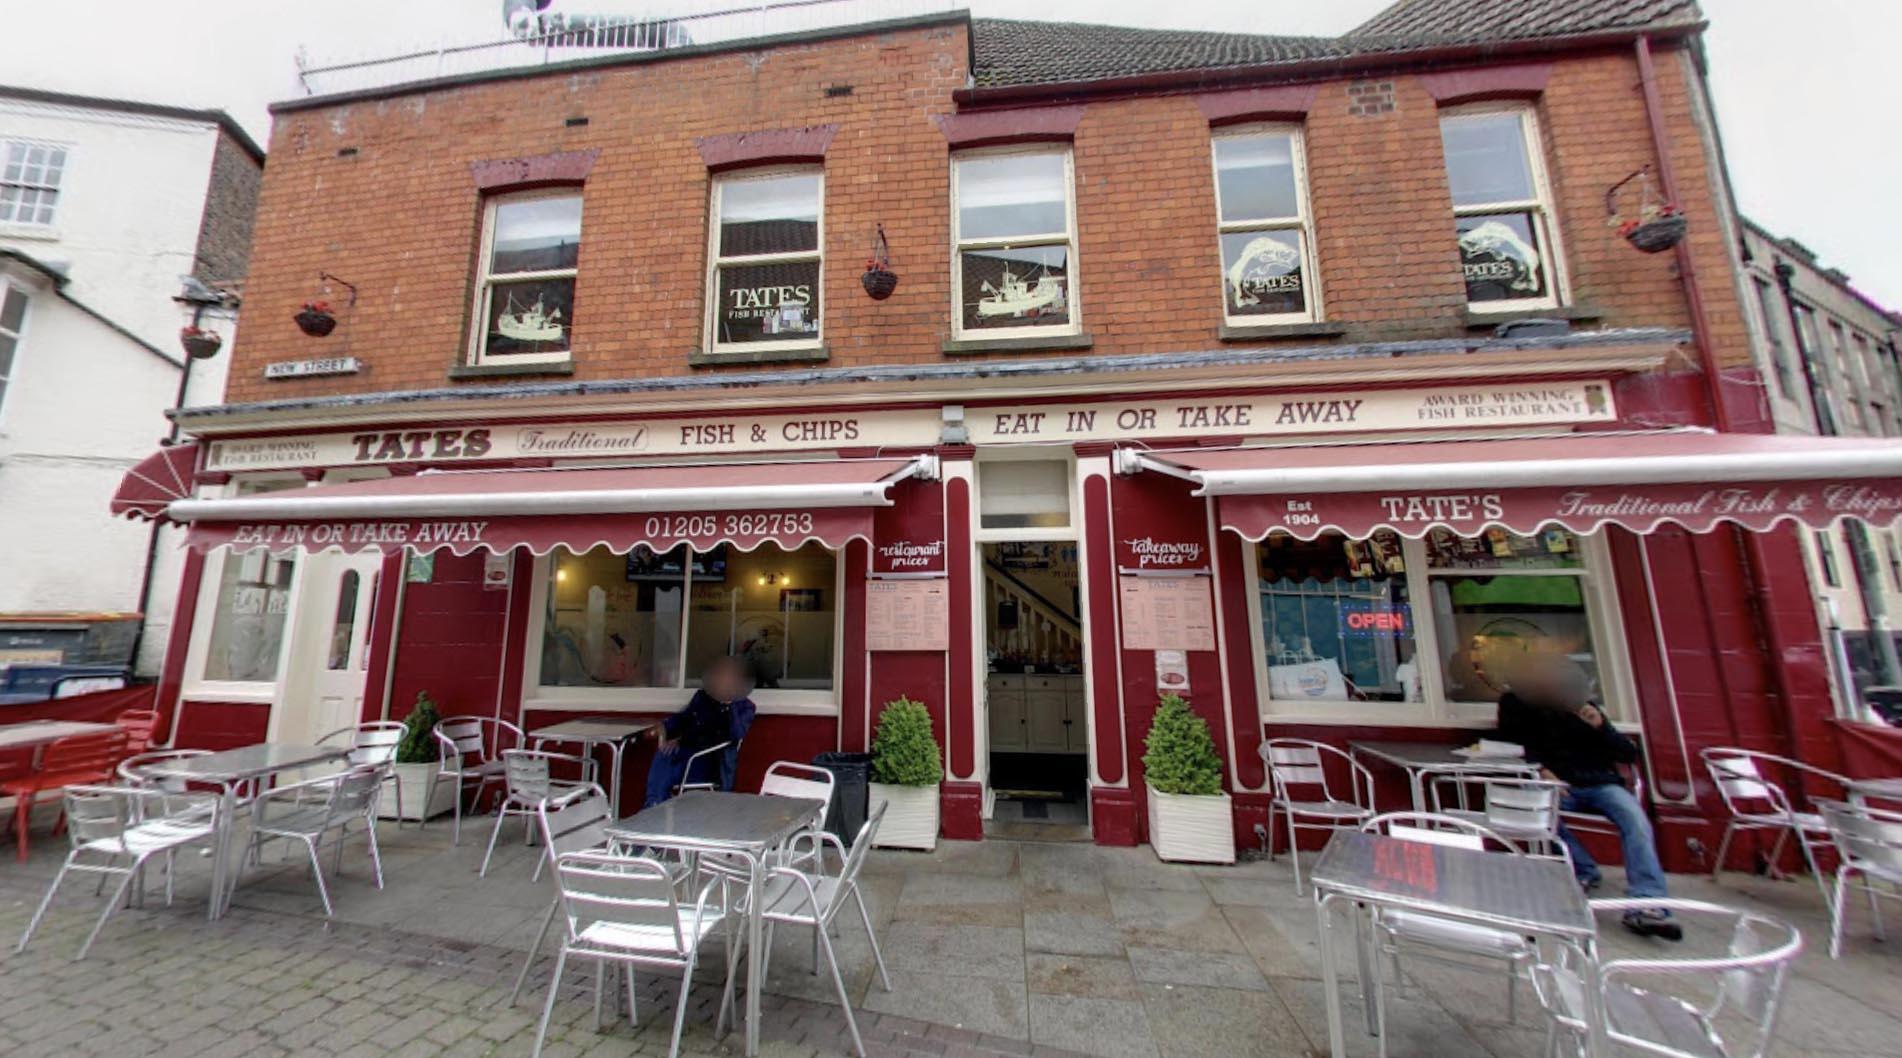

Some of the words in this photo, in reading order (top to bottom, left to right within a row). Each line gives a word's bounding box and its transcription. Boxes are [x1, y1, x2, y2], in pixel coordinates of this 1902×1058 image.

[730, 284, 811, 309] TATES
[728, 310, 750, 319] FISH
[271, 364, 296, 374] NEW
[304, 359, 346, 372] STREET
[1423, 393, 1483, 406] AWARD
[1492, 388, 1575, 403] WINNING
[993, 413, 1045, 435] EAT
[1065, 410, 1097, 432] IN
[1117, 408, 1157, 430] OR
[1178, 405, 1252, 428] TAKE
[1275, 400, 1363, 424] AWAY
[1418, 407, 1455, 419] FISH
[1465, 402, 1581, 417] RESTAURANT
[521, 425, 643, 450] Traditional
[680, 424, 735, 445] FISH
[750, 423, 767, 443] &
[782, 419, 859, 442] CHIPS
[352, 429, 492, 461] TATES
[1287, 500, 1312, 511] Est
[1381, 495, 1504, 522] TATE'S
[1557, 490, 1713, 516] Traditional
[1714, 487, 1780, 514] Fish
[1786, 495, 1811, 512] &
[645, 516, 717, 538] 01205
[724, 513, 813, 536] 362753
[1283, 514, 1320, 525] 1904
[233, 525, 280, 543] EAT
[281, 524, 309, 543] IN
[312, 523, 344, 543] OR
[349, 522, 409, 543] TAKE
[414, 521, 488, 542] AWAY
[879, 541, 944, 557] restaurant
[1124, 536, 1200, 561] takeaway
[891, 557, 929, 570] prices
[1140, 553, 1184, 568] prices
[1347, 613, 1404, 629] OPEN
